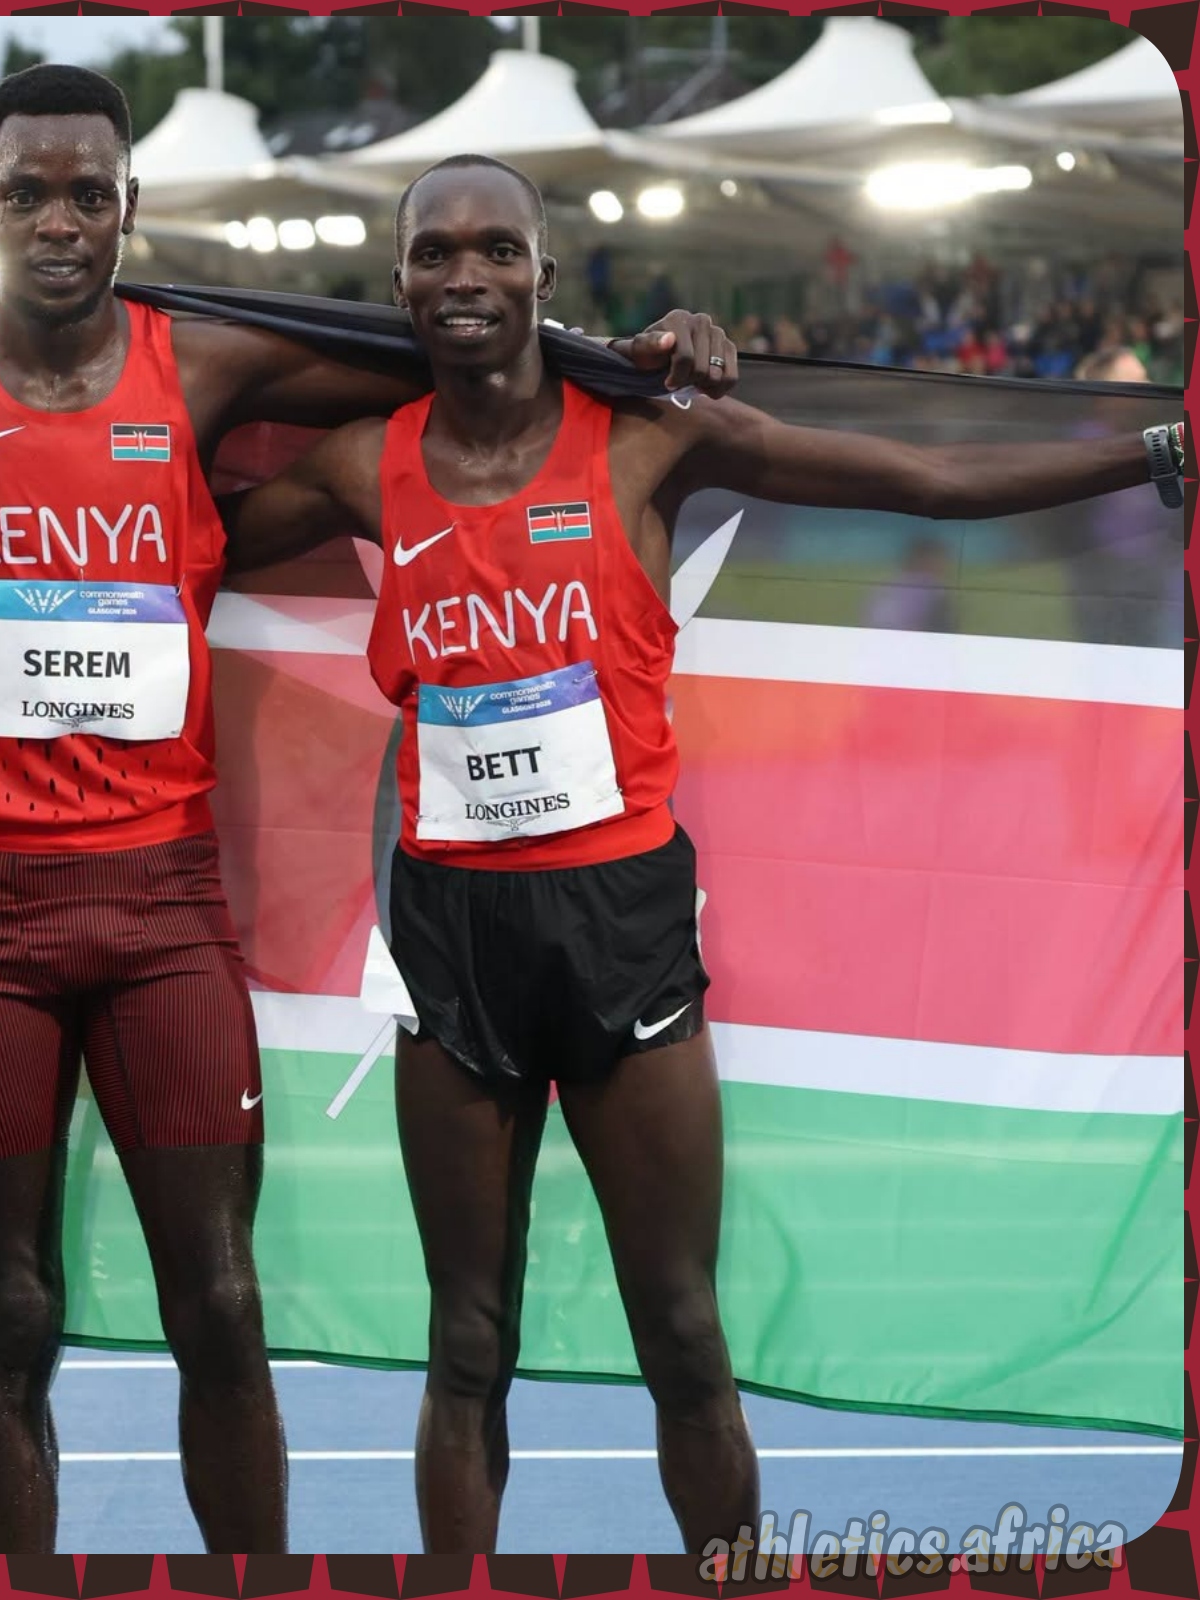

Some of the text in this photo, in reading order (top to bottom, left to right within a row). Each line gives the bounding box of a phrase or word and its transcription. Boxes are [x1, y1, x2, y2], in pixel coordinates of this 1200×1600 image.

[80, 590, 144, 599] commonwealth
[98, 598, 128, 607] games
[402, 580, 598, 665] KENYA
[23, 649, 131, 678] SEREM
[489, 680, 557, 700] commonwealth
[509, 692, 541, 706] games
[21, 701, 135, 719] LONGINES
[466, 745, 542, 781] BETT
[465, 792, 571, 821] LONGINES
